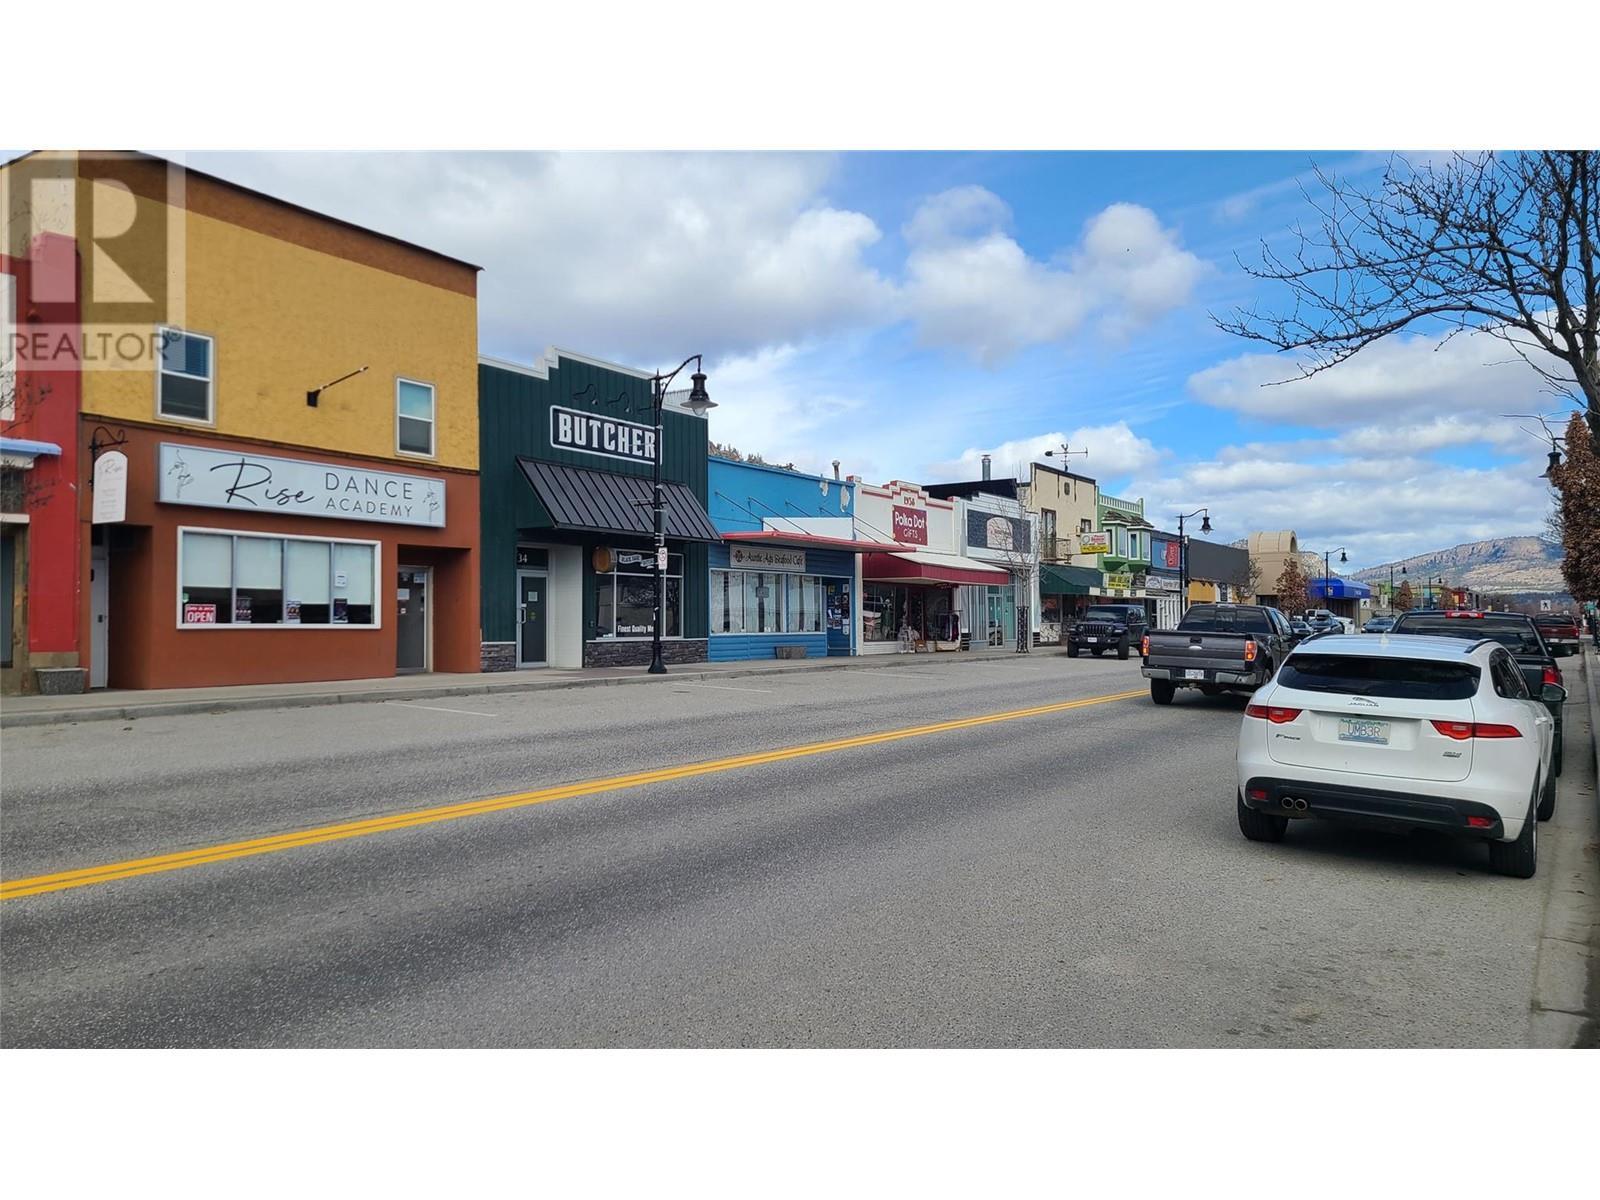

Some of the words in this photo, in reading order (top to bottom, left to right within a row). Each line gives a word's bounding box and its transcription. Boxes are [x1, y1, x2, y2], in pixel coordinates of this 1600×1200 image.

[558, 412, 656, 458] BUTCHER
[210, 457, 315, 507] Rise
[325, 472, 413, 500] DANCE
[325, 497, 413, 517] ACADEMY
[894, 511, 913, 528] Polka
[913, 514, 925, 529] Dot
[187, 611, 214, 622] OPEN
[617, 625, 631, 633] Finest
[632, 625, 647, 634] Quality
